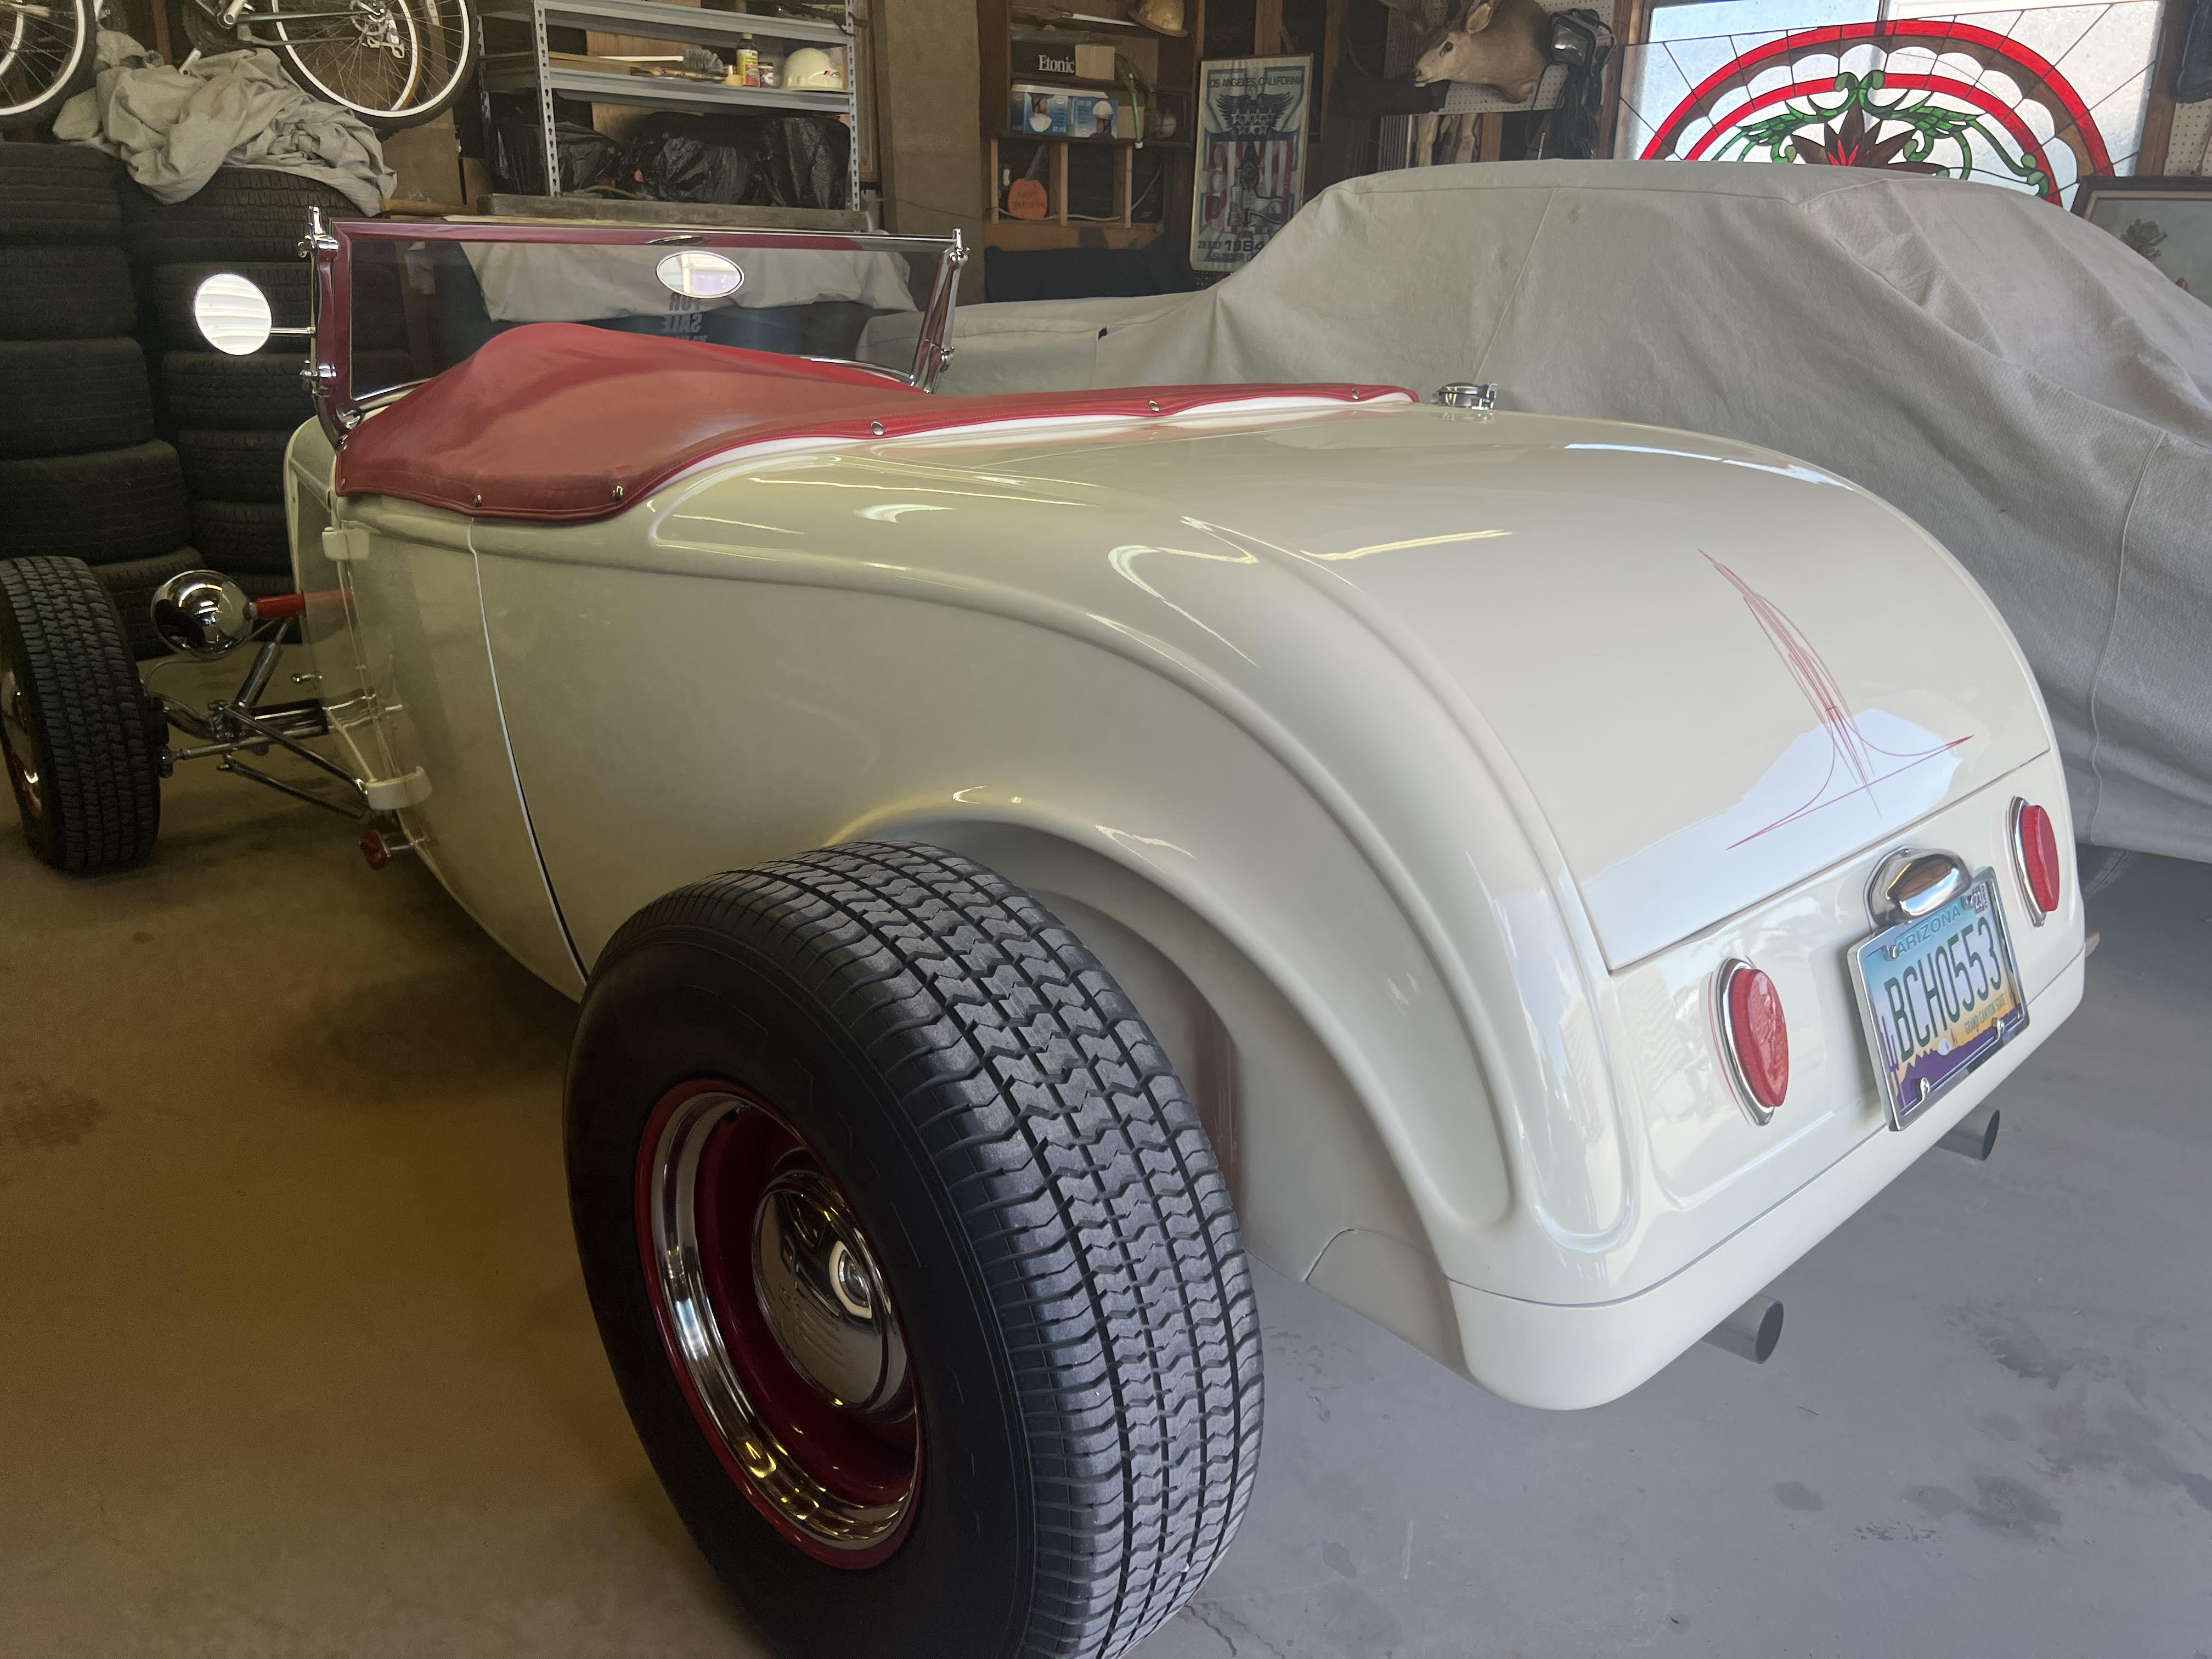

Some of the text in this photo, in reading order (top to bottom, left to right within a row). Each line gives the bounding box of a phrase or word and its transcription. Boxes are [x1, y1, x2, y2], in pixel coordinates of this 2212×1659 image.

[1038, 54, 1075, 74] Etonic
[1207, 78, 1220, 88] LOS
[1224, 240, 1265, 252] 1984
[1972, 890, 1983, 909] 23
[1898, 905, 1962, 955] ARIZONA
[1884, 916, 2002, 1063] BCH0553
[1965, 994, 2006, 1035] GRAND CANYON STATE
